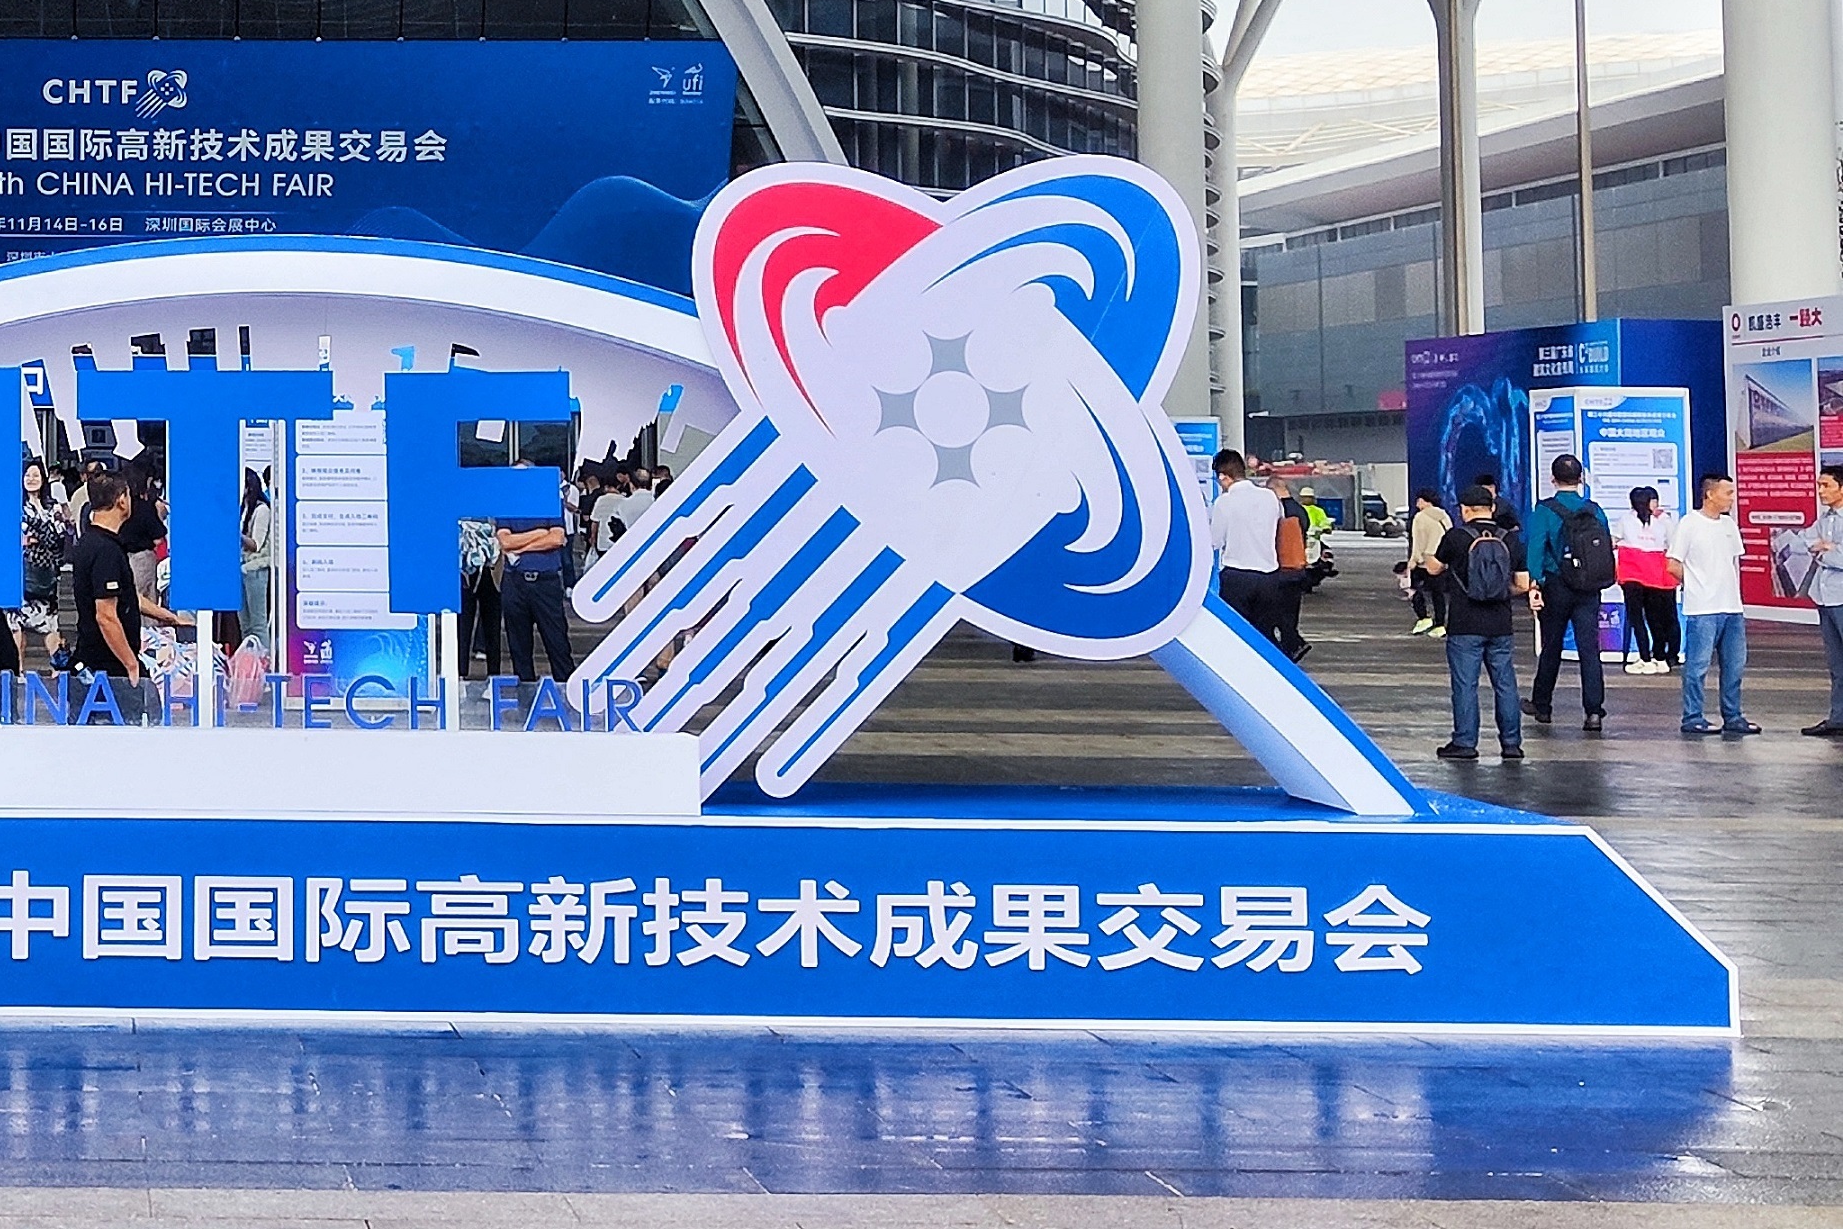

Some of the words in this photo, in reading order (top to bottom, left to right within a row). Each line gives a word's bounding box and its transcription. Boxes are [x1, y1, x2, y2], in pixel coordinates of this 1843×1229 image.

[42, 78, 138, 105] CHTF
[36, 170, 134, 196] CHINA
[145, 171, 260, 197] HI-TECH
[272, 172, 334, 198] FAIR
[145, 216, 277, 233] 深圳国际会展中心
[162, 673, 447, 730] HI-TECH
[489, 675, 645, 732] FAIR
